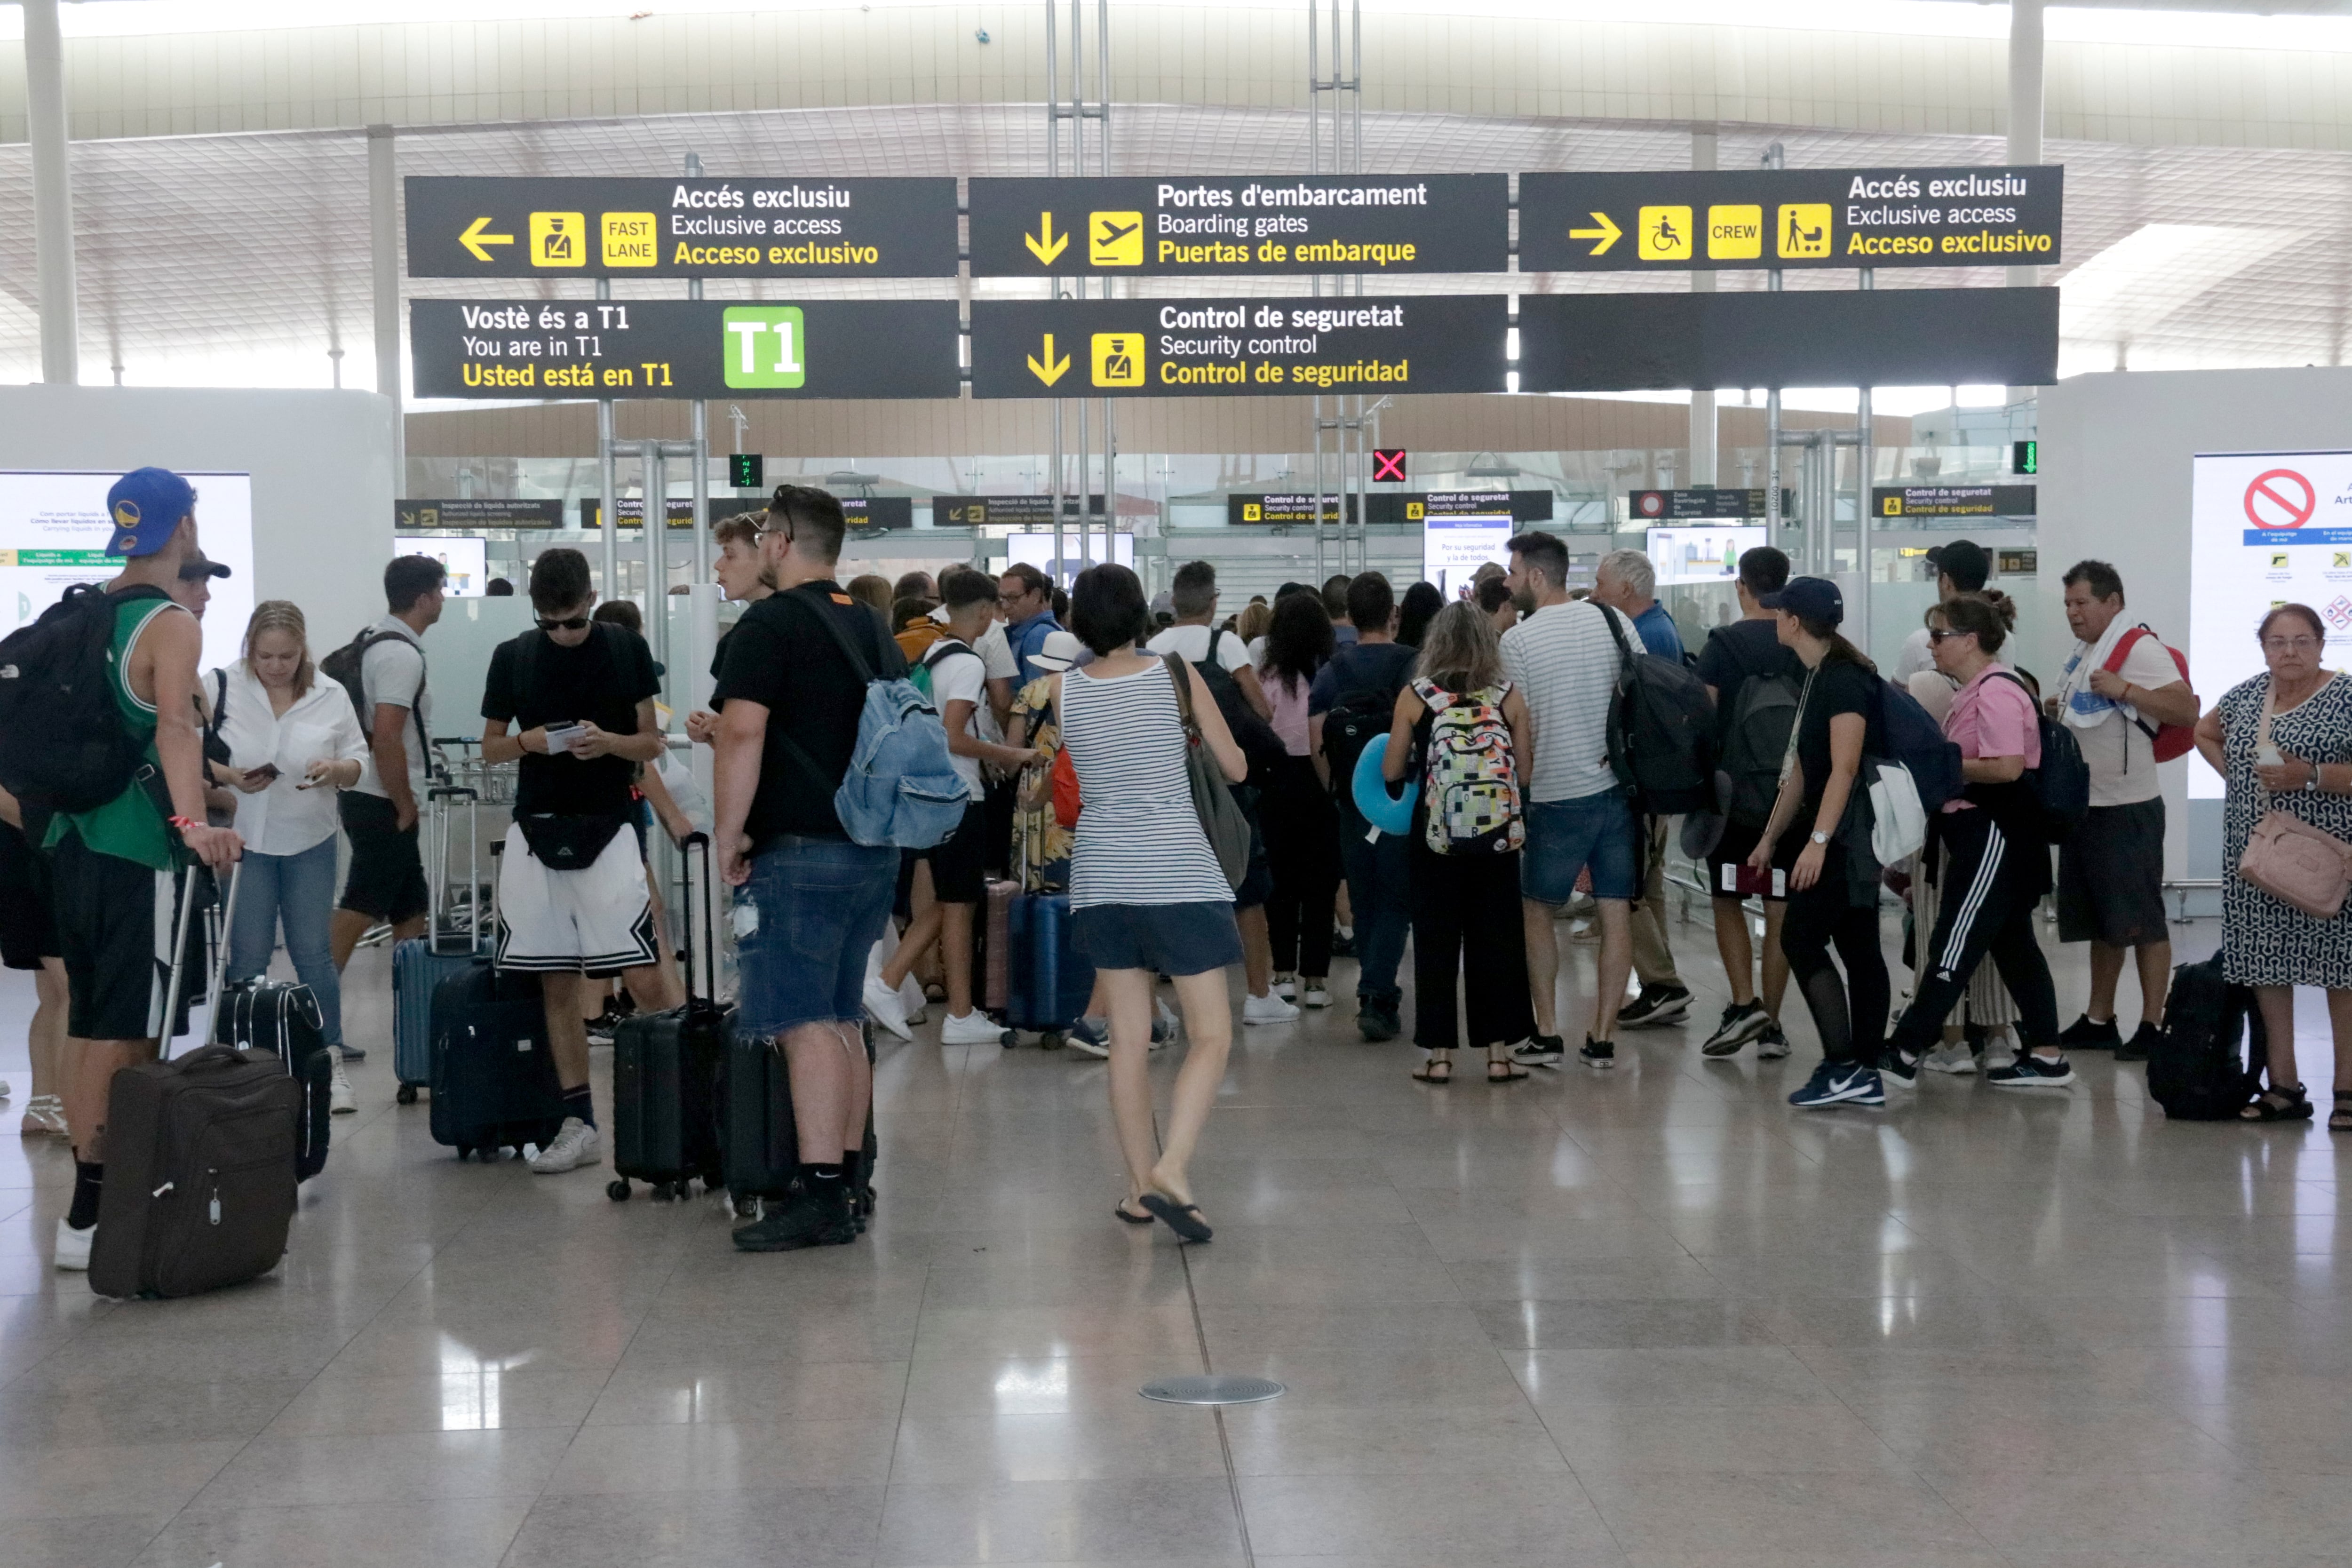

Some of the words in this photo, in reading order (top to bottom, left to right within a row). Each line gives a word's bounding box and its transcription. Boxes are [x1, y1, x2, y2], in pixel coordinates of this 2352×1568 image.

[672, 184, 745, 208] Accés
[753, 185, 850, 208] exclusiu
[1158, 184, 1233, 207] Portes
[1241, 183, 1427, 207] d'embarcament
[1848, 174, 1921, 199] Accés
[1929, 173, 2026, 198] exclusiu
[672, 215, 766, 235] Exclusive
[773, 219, 842, 235] access
[1158, 214, 1248, 238] Boarding
[1255, 216, 1308, 238] gates
[1847, 204, 1941, 225] Exclusive
[1947, 207, 2016, 223] access
[609, 222, 649, 236] FAST
[1712, 225, 1757, 239] CREW
[608, 243, 652, 257] LANE
[674, 241, 760, 264] Acceso
[768, 241, 878, 264] exclusivo
[1159, 240, 1249, 263] Puertas
[1257, 239, 1287, 262] de
[1295, 239, 1415, 266] embarque
[1847, 232, 1933, 255] Acceso
[1941, 230, 2051, 253] exclusivo
[461, 305, 530, 329] Vostè
[539, 305, 566, 329] és
[574, 311, 588, 329] a
[597, 306, 629, 329] T1
[1160, 305, 1246, 329] Control
[1254, 305, 1284, 328] de
[1292, 305, 1403, 331] seguretat
[462, 336, 501, 356] You
[509, 341, 541, 356] are
[549, 336, 568, 356] in
[575, 336, 602, 356] T1
[728, 322, 801, 373] T1
[1160, 335, 1242, 358] Security
[1248, 334, 1317, 354] control
[463, 363, 534, 387] Usted
[543, 362, 594, 386] está
[603, 369, 633, 386] en
[641, 363, 673, 386] T1
[1160, 361, 1246, 384] Control
[1255, 361, 1284, 383] de
[1292, 359, 1407, 387] seguridad
[1772, 470, 1780, 481] SE
[1471, 493, 1510, 502] seguretat
[1951, 488, 1992, 497] seguretat
[1951, 504, 1993, 514] seguridad
[1463, 543, 1496, 552] seguridad
